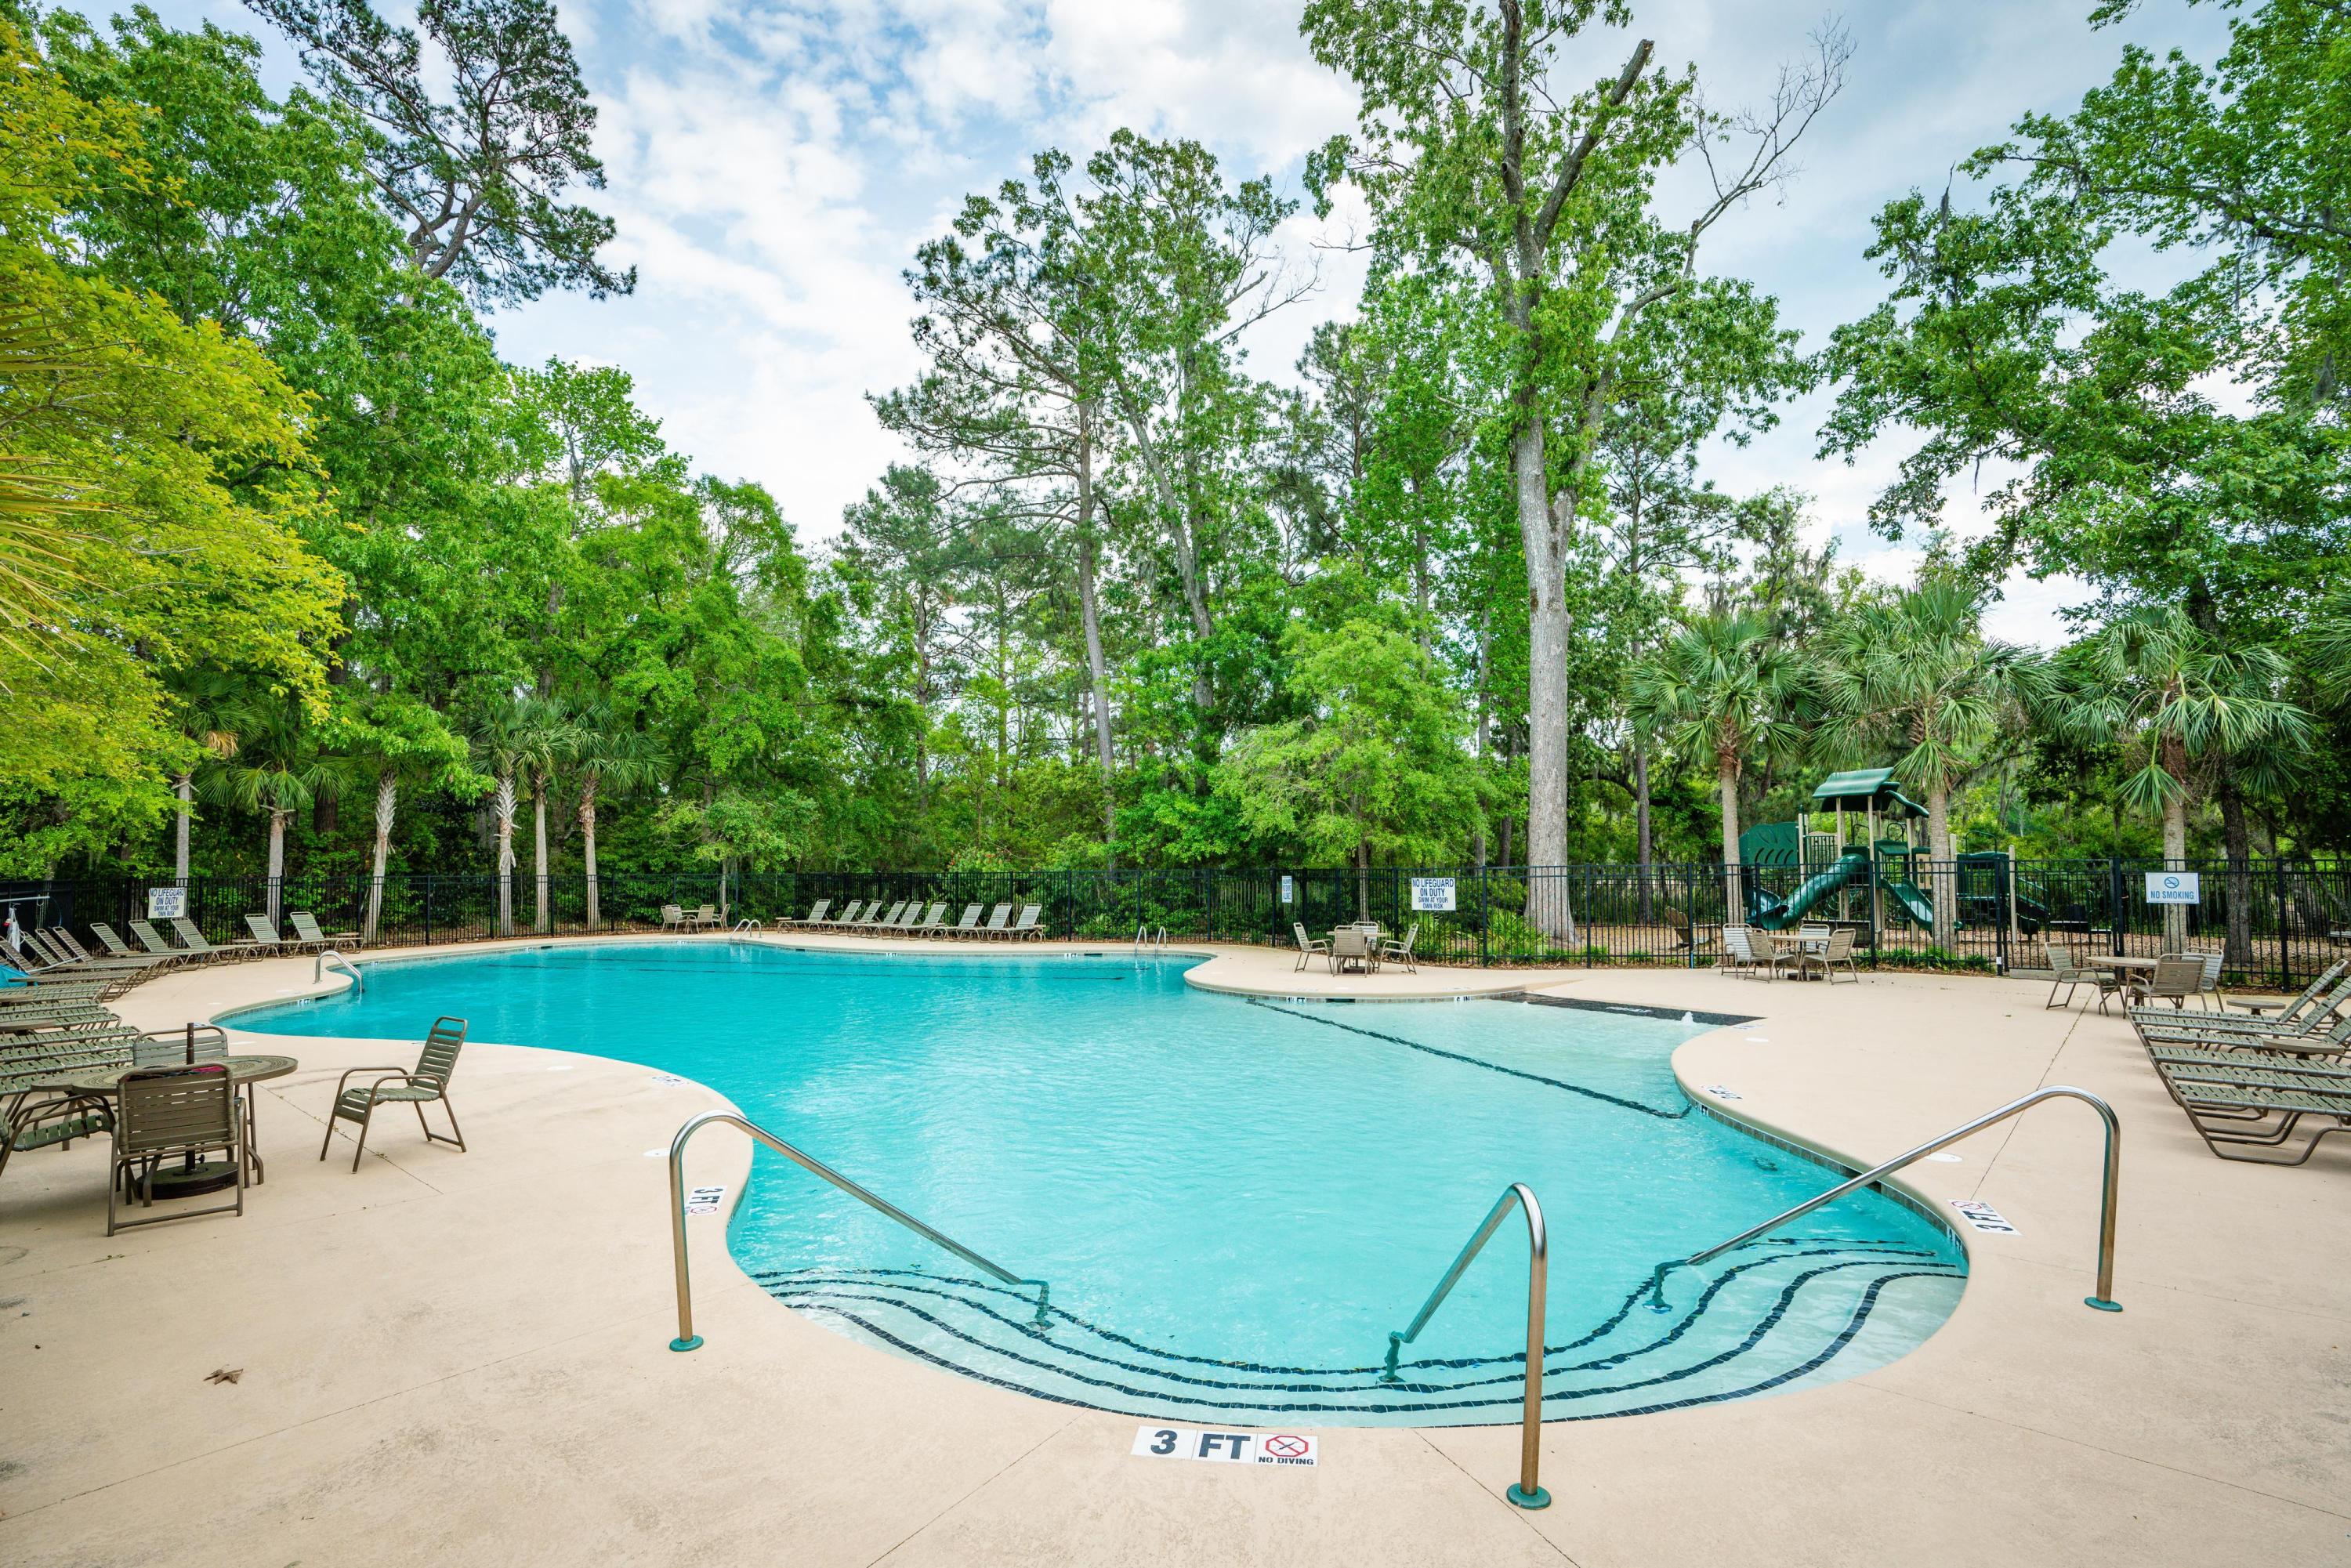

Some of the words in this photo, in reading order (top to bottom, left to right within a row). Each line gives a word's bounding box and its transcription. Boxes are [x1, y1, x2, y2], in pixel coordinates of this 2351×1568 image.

[1412, 878, 1419, 887] NO
[1421, 878, 1454, 887] LIFEGUARD
[1420, 888, 1428, 896] ON
[1429, 888, 1444, 896] DUTY
[2150, 890, 2160, 899] NO
[2162, 890, 2194, 899] SMOKING
[165, 896, 178, 905] DUTY
[1962, 1211, 2004, 1222] FT
[1150, 1430, 1178, 1454] 3
[1198, 1433, 1251, 1460] FT
[1277, 1457, 1314, 1465] DIVING
